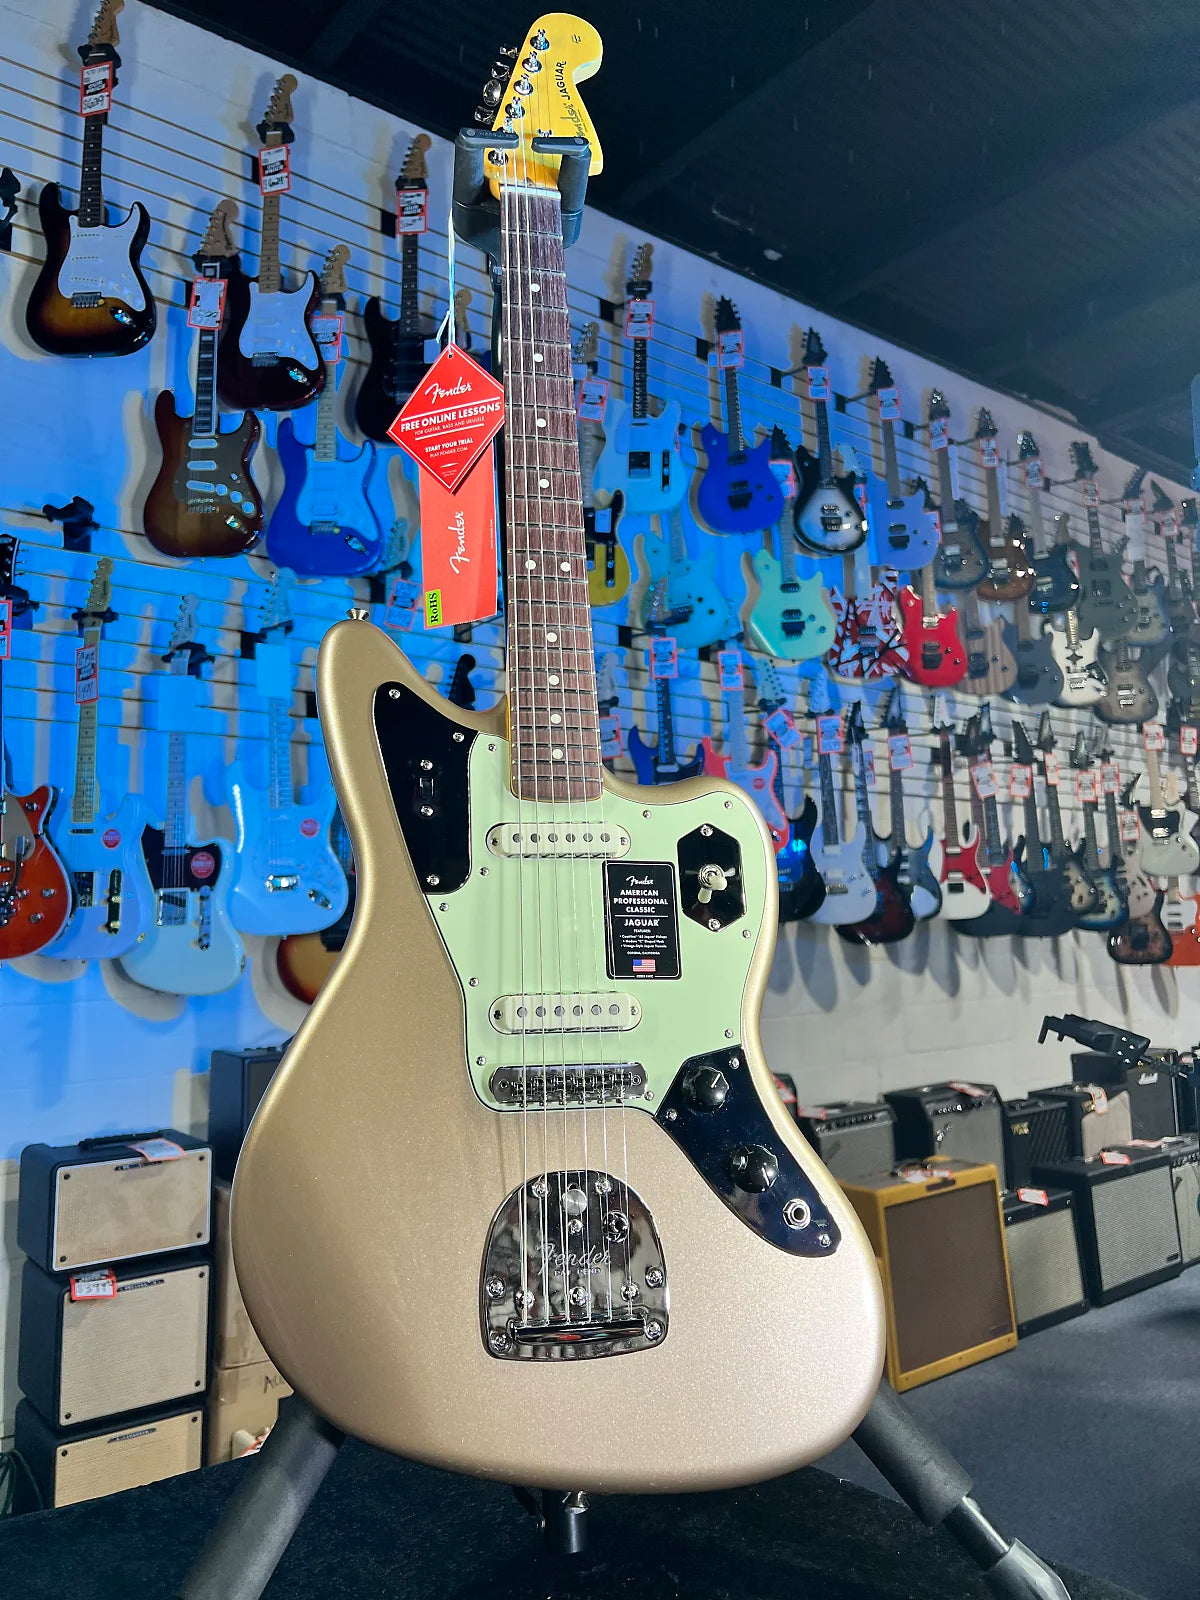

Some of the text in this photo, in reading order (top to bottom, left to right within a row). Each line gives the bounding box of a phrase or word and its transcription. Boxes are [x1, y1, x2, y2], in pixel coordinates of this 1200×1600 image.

[555, 61, 571, 100] JAGUAR
[424, 377, 473, 404] Fender
[401, 403, 501, 432] FREE ONLINE LESSONS
[425, 437, 474, 453] START YOUR TRIAL
[447, 510, 471, 575] Fender
[429, 592, 438, 624] RoHS
[626, 875, 654, 886] Fender
[623, 919, 660, 927] JAGUAR
[625, 906, 656, 914] CLASSIC
[535, 1243, 611, 1276] Fender
